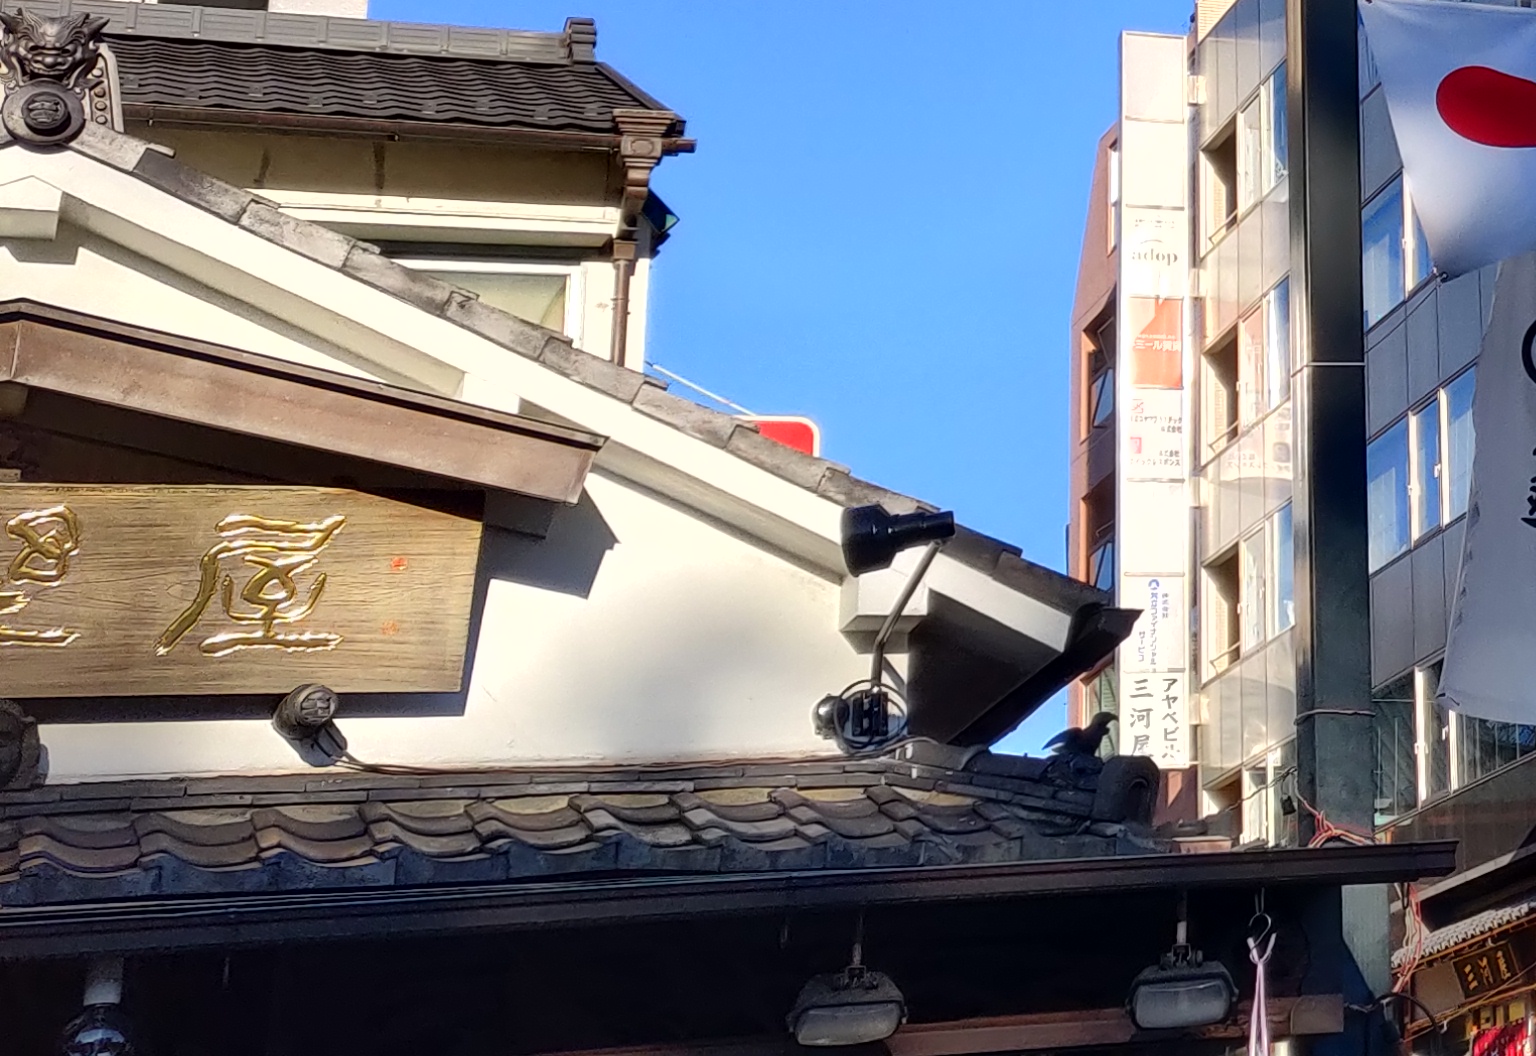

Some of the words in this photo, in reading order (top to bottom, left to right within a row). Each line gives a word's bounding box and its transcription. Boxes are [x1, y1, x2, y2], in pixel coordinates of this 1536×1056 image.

[1129, 678, 1154, 756] 三河屋
[1161, 677, 1181, 759] アヤベビル
